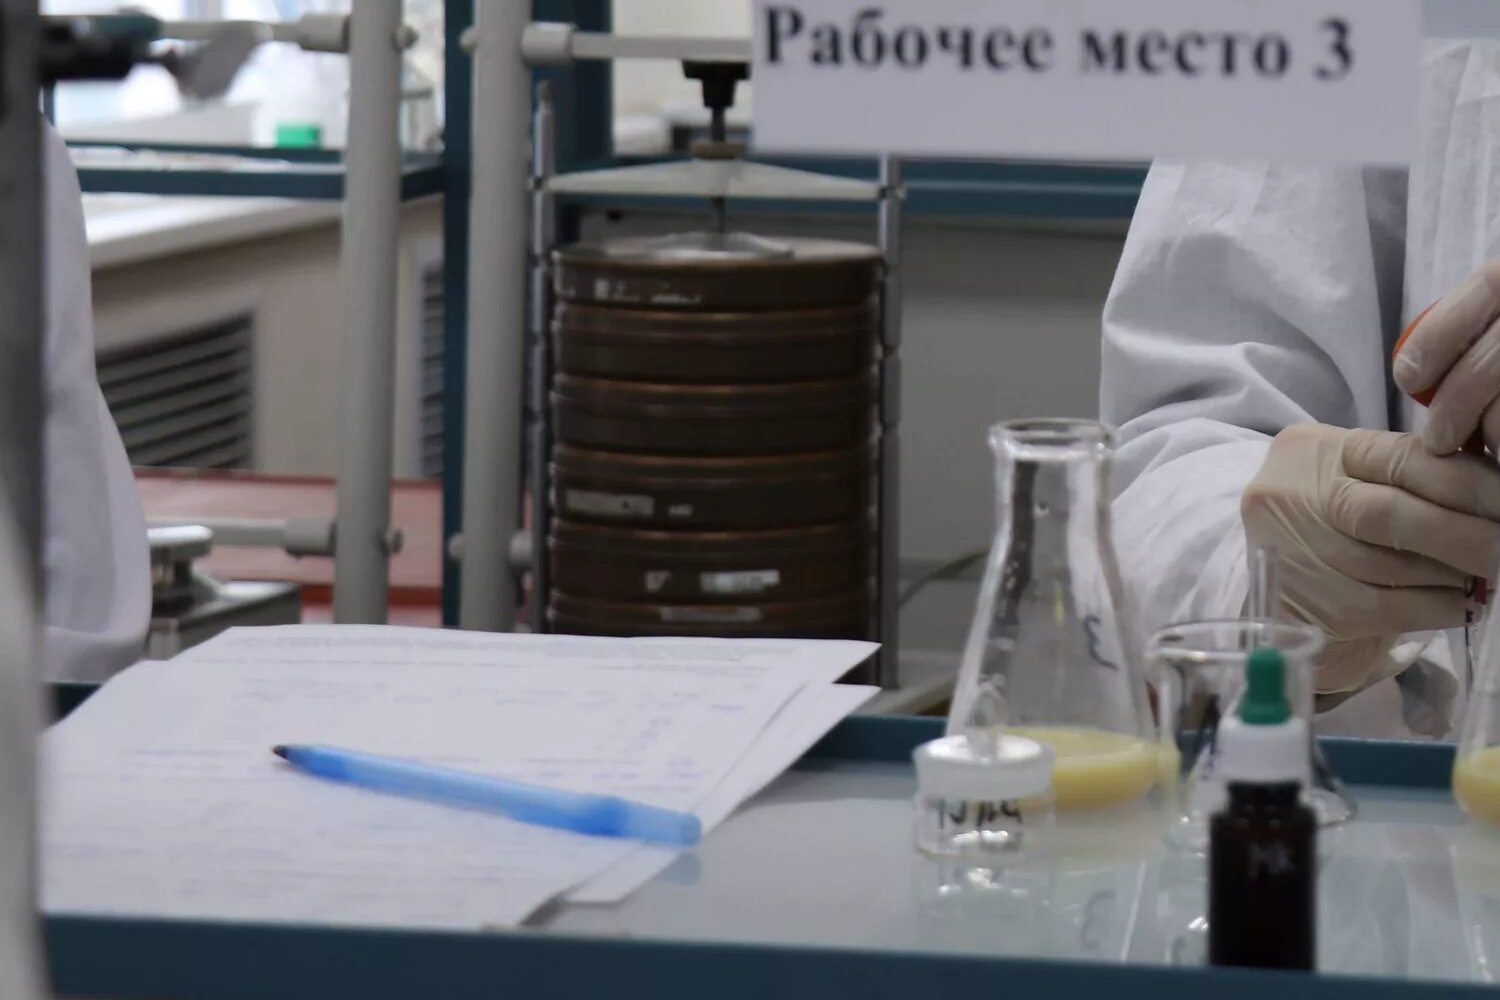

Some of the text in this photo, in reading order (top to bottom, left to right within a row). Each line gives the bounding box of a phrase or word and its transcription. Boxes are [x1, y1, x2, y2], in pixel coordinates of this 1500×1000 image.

[763, 4, 1354, 80] Рабочее место 3
